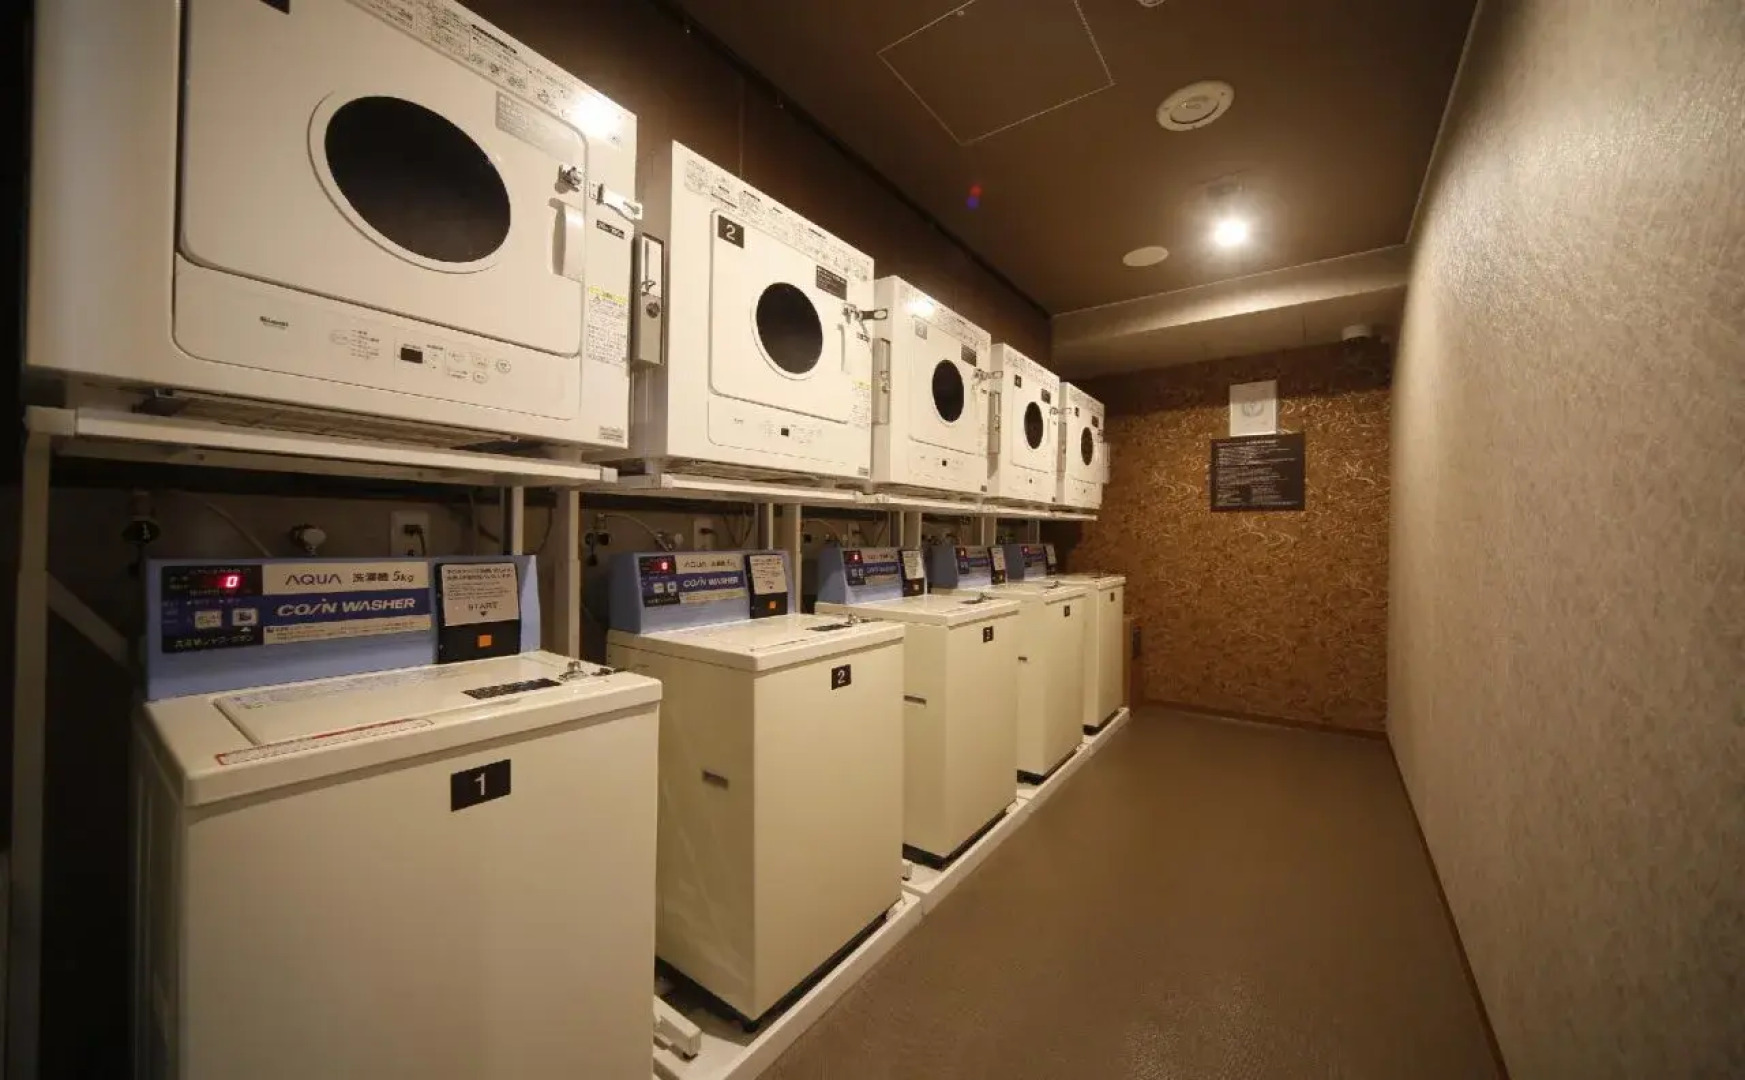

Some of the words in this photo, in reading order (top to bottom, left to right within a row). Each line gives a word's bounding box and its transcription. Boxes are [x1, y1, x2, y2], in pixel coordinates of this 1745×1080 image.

[726, 224, 736, 241] 2
[226, 576, 239, 588] 0
[285, 573, 342, 586] AQUA
[392, 570, 415, 583] 5kg
[341, 597, 416, 612] WASHER
[837, 669, 846, 684] 2
[474, 772, 486, 796] 1
